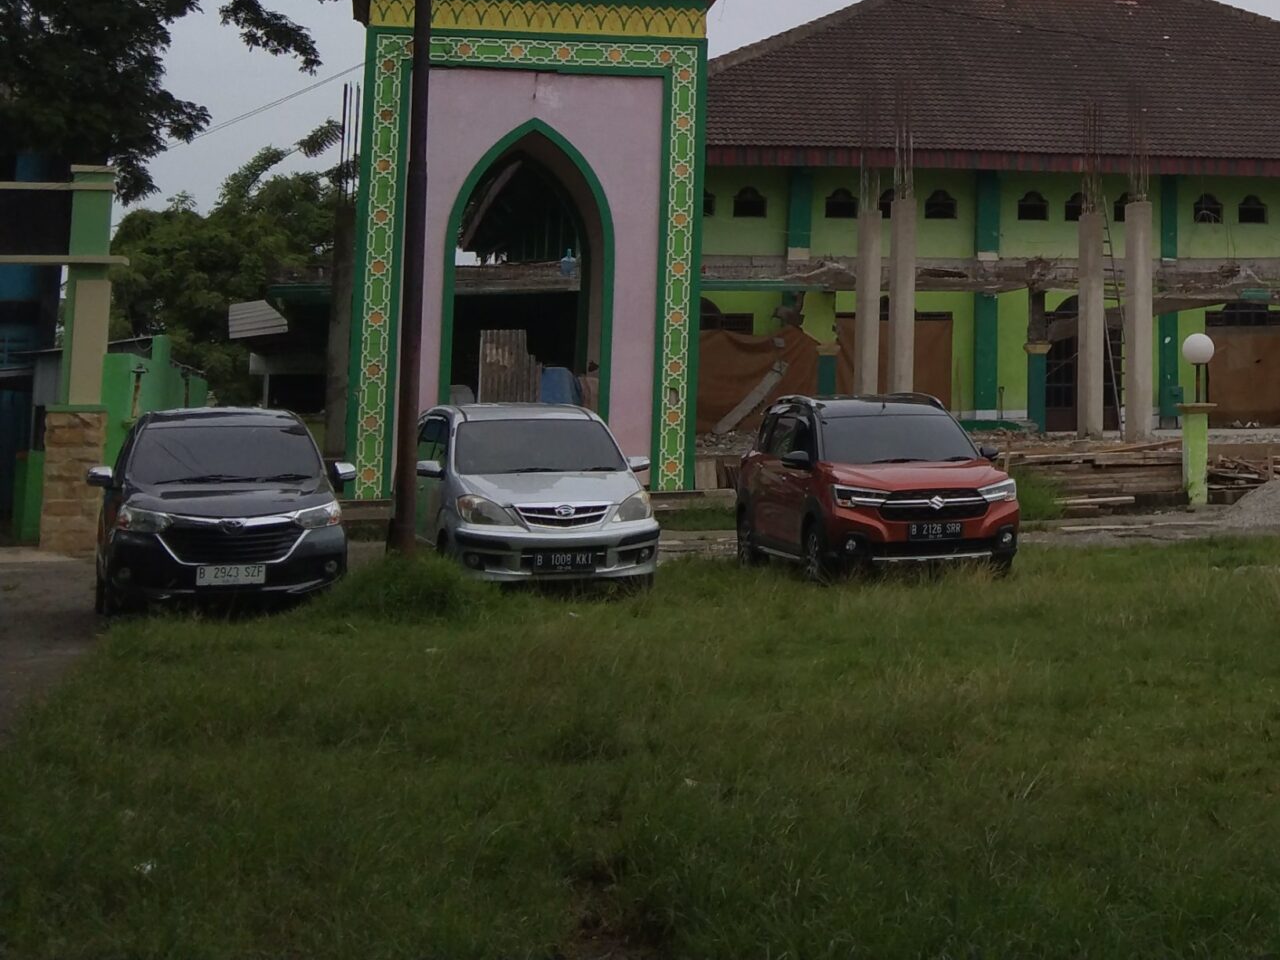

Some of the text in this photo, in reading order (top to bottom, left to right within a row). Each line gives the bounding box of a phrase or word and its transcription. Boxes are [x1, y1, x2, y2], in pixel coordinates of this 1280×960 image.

[911, 523, 961, 536] B 2126 SRR
[537, 554, 543, 566] B
[199, 567, 206, 579] B
[244, 565, 263, 577] SZF
